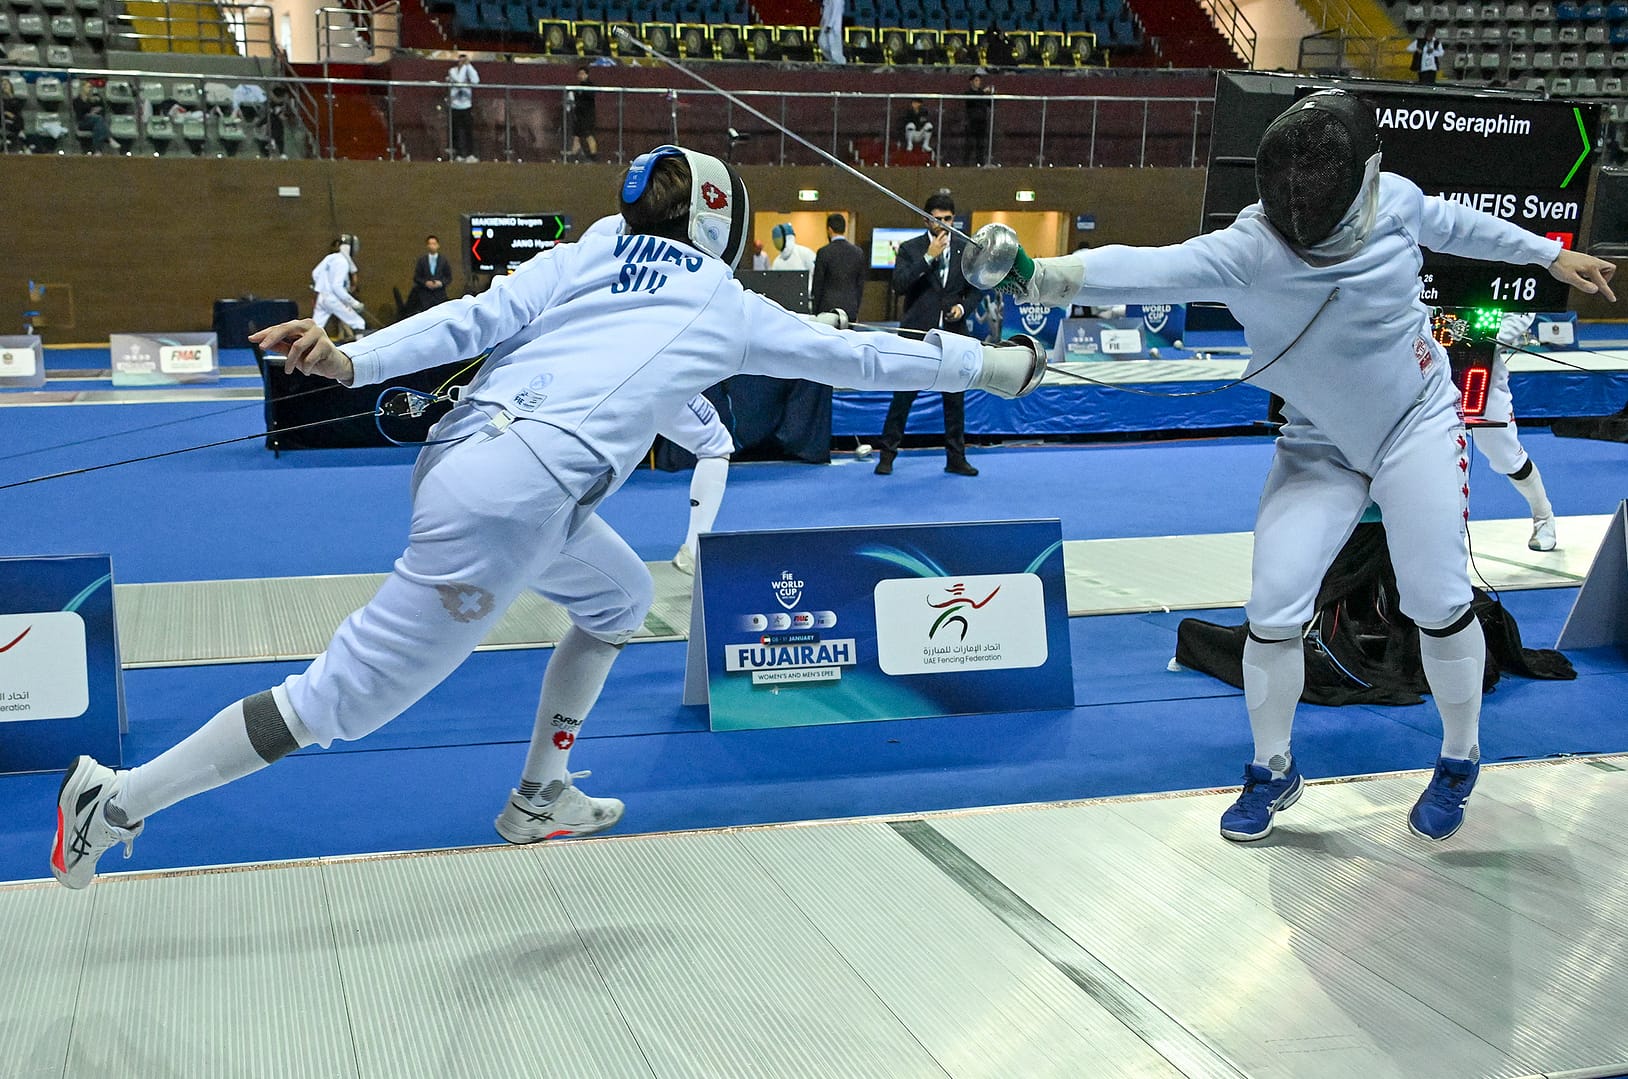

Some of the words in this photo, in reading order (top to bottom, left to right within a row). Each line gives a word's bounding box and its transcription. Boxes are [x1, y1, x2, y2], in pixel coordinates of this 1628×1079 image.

[1443, 111, 1531, 137] Seraphim
[1522, 194, 1578, 220] Sven
[1424, 274, 1434, 282] 26
[1420, 287, 1438, 300] tch
[1490, 277, 1537, 301] 1:18
[1019, 306, 1050, 315] WORLD
[1142, 304, 1172, 313] WORLD
[1148, 312, 1165, 320] CUP
[171, 350, 202, 361] FMAC
[1462, 368, 1488, 413] 0
[771, 580, 804, 589] WORLD
[780, 588, 797, 596] CUP
[983, 643, 1001, 652] اتحاد
[738, 643, 849, 668] FUJAIRAH
[937, 656, 964, 664] Fencing
[965, 654, 1002, 662] Federation
[758, 672, 787, 680] WOMEN'S
[8, 691, 29, 700] اتحاد
[0, 703, 31, 712] eration
